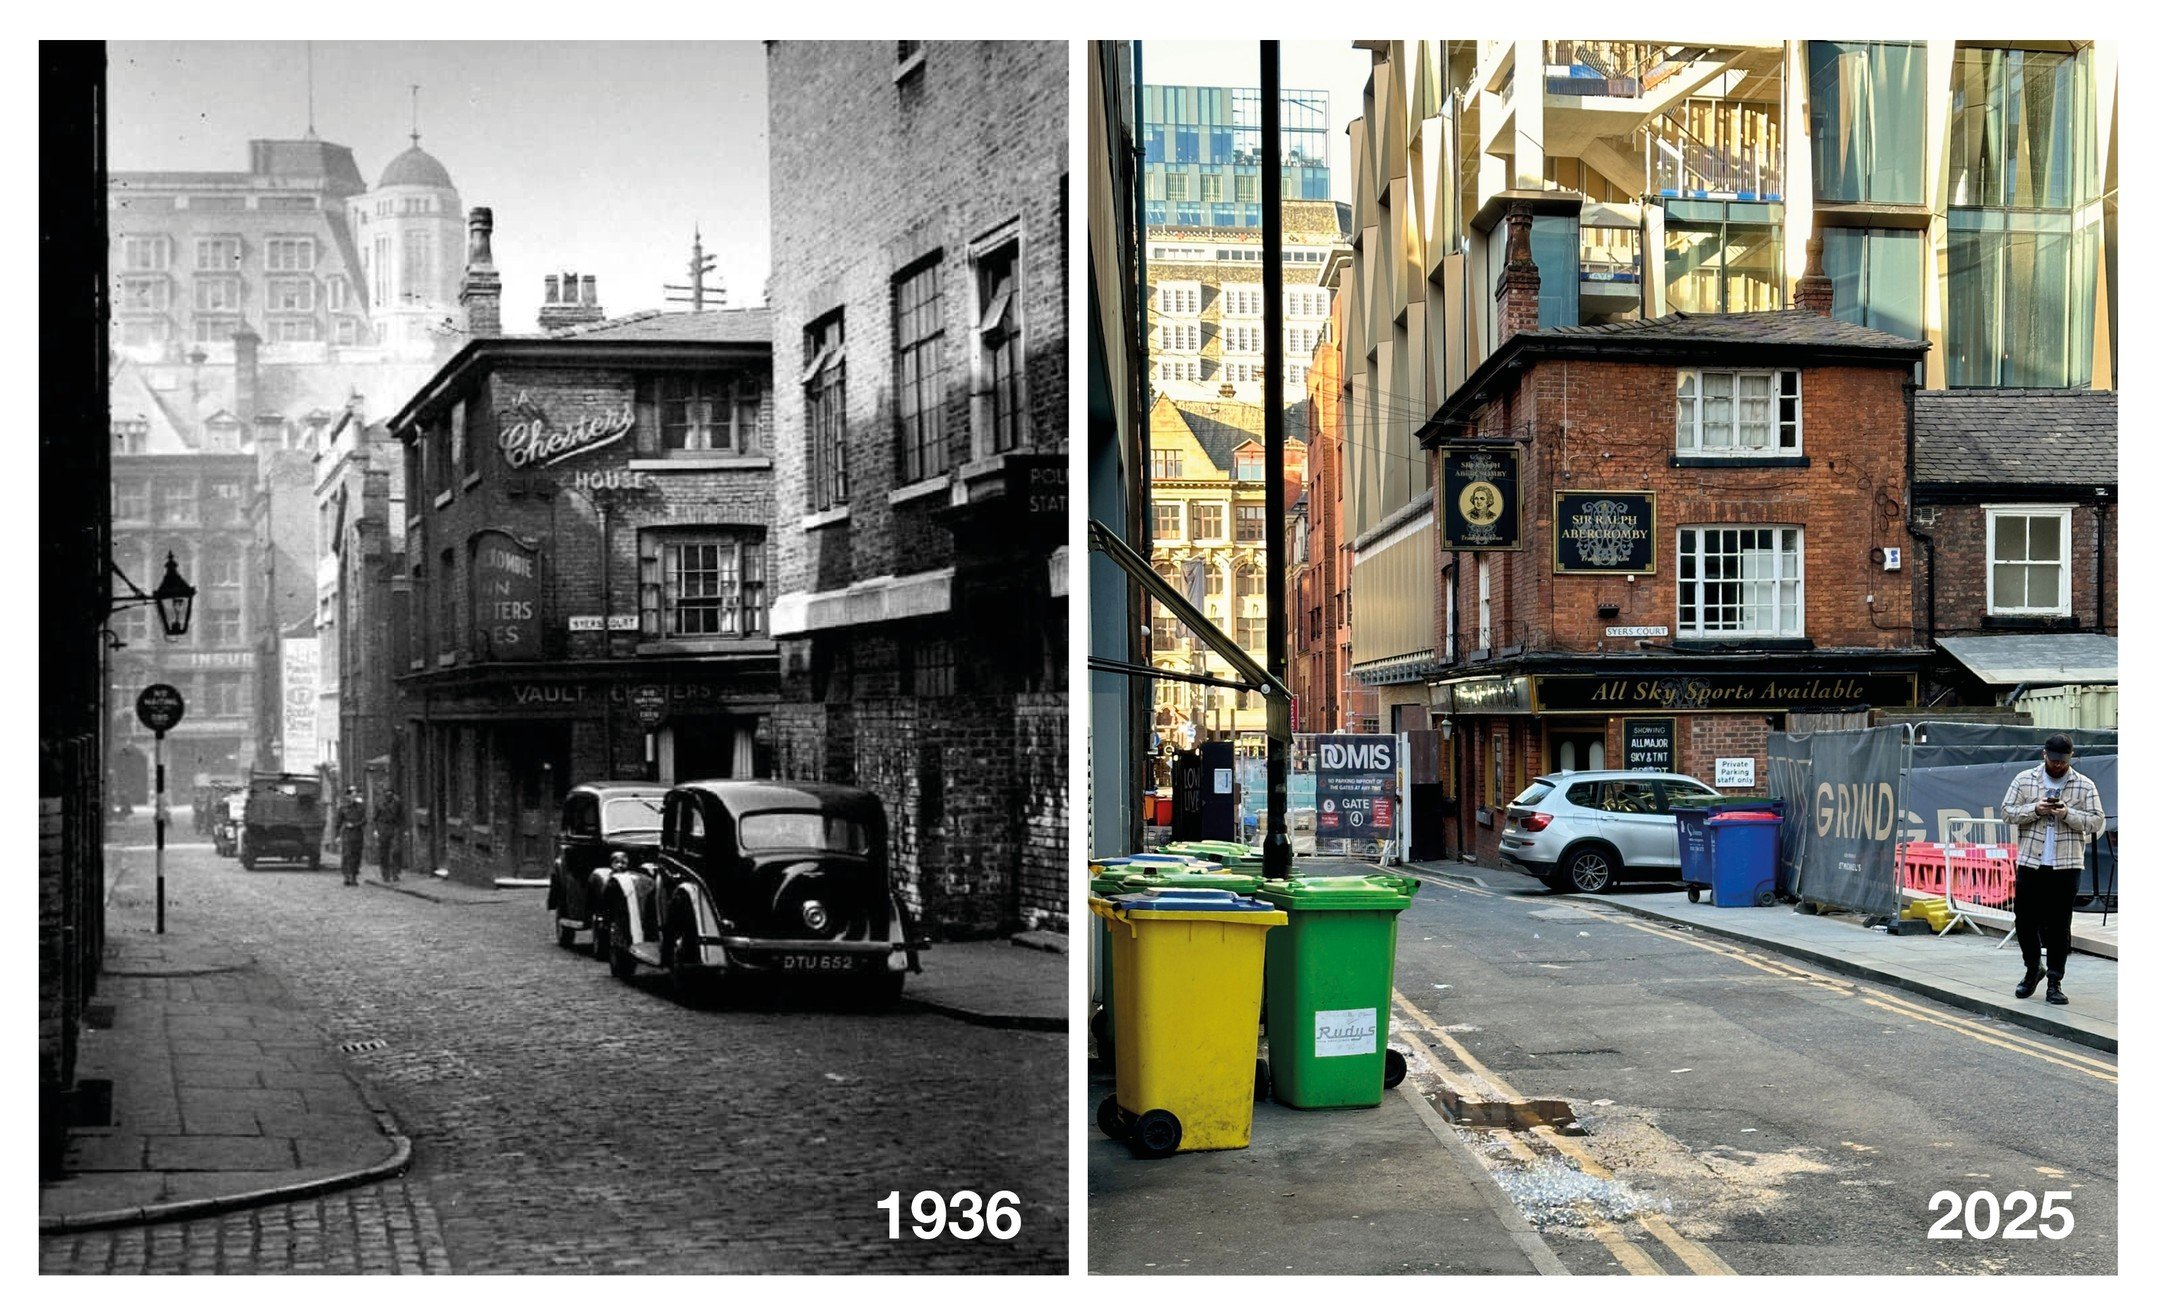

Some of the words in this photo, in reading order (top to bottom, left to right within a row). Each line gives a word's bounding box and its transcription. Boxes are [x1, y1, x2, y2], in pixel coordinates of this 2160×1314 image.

[499, 399, 635, 468] Chesters
[575, 470, 646, 490] HOUSE
[1572, 515, 1593, 525] SIR
[1596, 515, 1637, 525] RALPH
[1562, 529, 1648, 539] ABERCROMBY
[513, 685, 587, 703] VAULT
[1592, 681, 1626, 700] All
[1633, 682, 1677, 705] Sky
[1686, 682, 1753, 705] Sports
[1760, 680, 1863, 700] Available
[1320, 744, 1391, 770] DOMIS
[1630, 752, 1645, 762] SKY
[1646, 752, 1652, 762] &
[1653, 752, 1668, 762] TNT
[1721, 769, 1750, 777] Parking
[1342, 798, 1370, 809] GATE
[1353, 813, 1360, 824] 4
[1816, 782, 1894, 841] GRIND
[784, 956, 816, 969] DTU
[1316, 1025, 1376, 1041] Rudys
